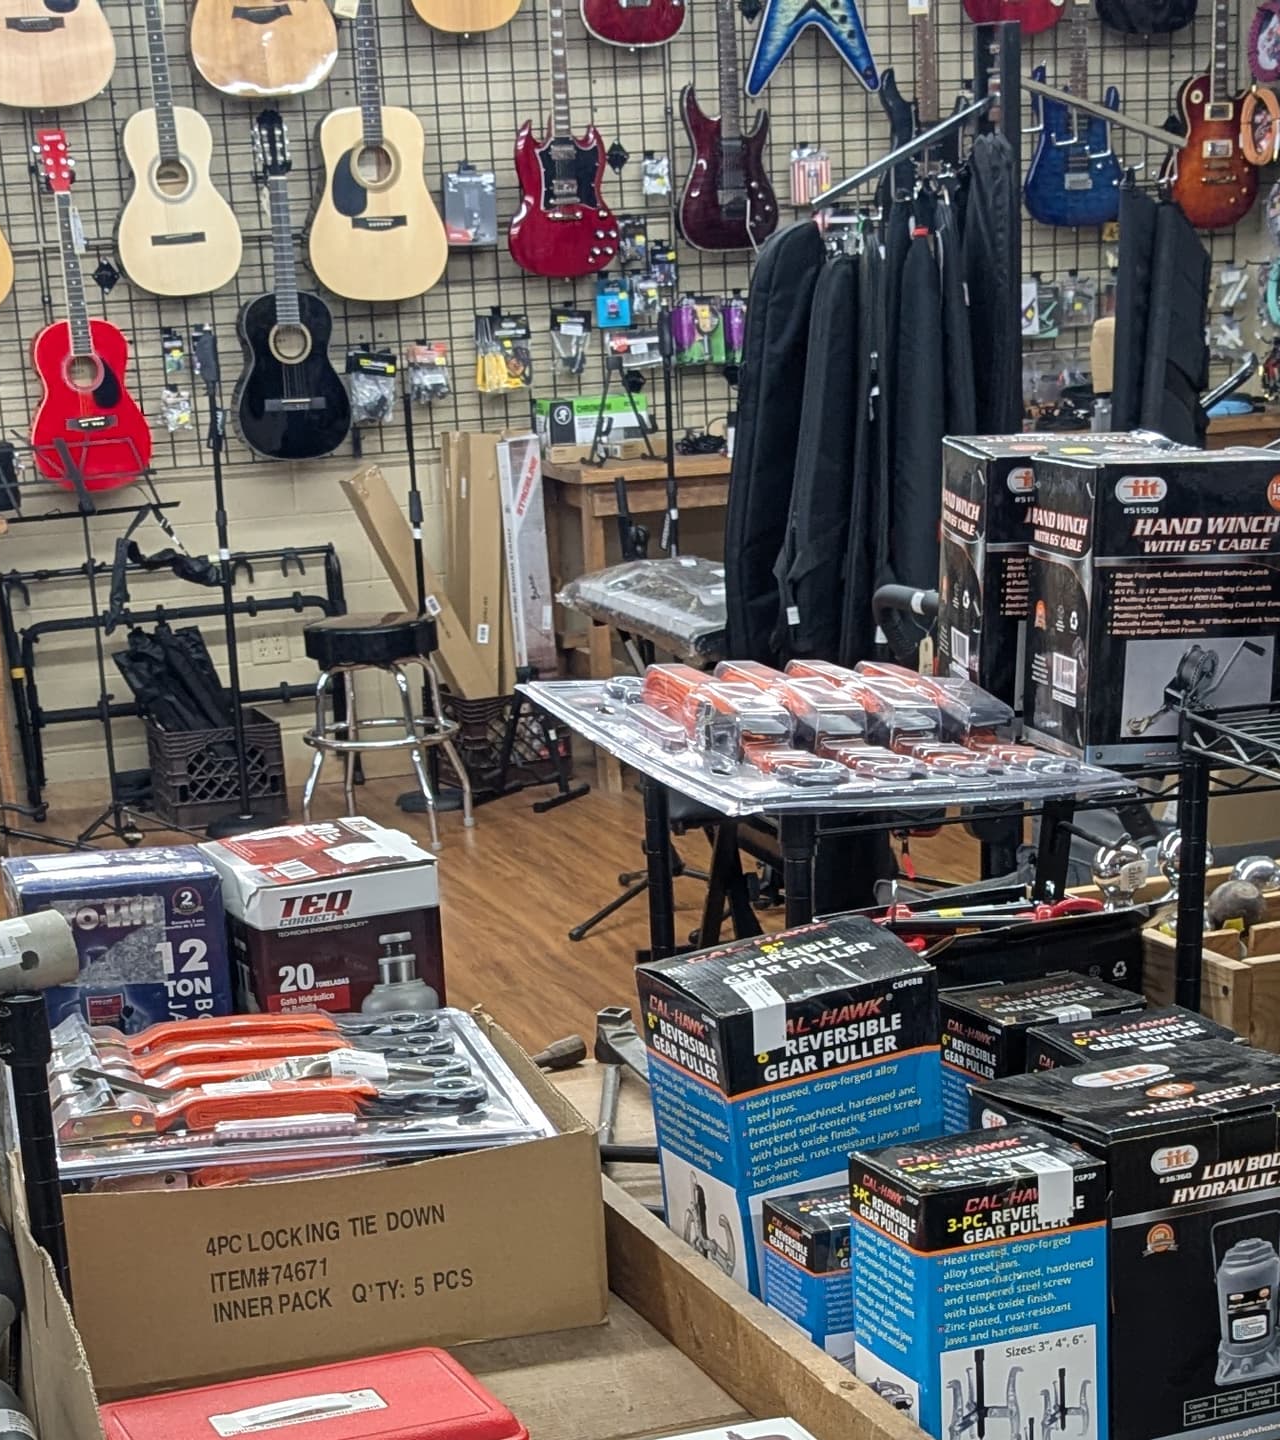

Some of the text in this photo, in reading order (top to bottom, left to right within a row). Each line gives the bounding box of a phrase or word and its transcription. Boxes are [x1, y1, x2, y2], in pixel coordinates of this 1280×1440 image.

[1123, 506, 1159, 514] #51550
[1132, 516, 1203, 536] HAND
[1144, 538, 1271, 553] WITH CABLE
[279, 889, 353, 919] TEQ
[154, 938, 209, 975] 12
[787, 941, 877, 970] PULLER
[164, 976, 212, 998] TON
[278, 962, 315, 993] 20
[786, 995, 884, 1035] AL-HAWK
[659, 1018, 718, 1066] REVERSIBLE
[785, 1013, 902, 1057] REVERSIBLE
[1098, 1020, 1201, 1043] REVERSIBLE
[1133, 1027, 1207, 1048] PULLER
[652, 1033, 720, 1085] GEAR PULLER
[764, 1035, 898, 1082] GEAR PULLER
[944, 1049, 995, 1081] GEAR PULLER
[952, 1037, 998, 1067] REVERSIBLE
[813, 1064, 898, 1091] drop-forged alloy
[848, 1090, 896, 1109] hardened
[1201, 1159, 1245, 1181] LOW
[1171, 1174, 1278, 1205] HYDRAULIC
[859, 1203, 910, 1244] GEAR PULLER
[871, 1196, 917, 1235] REVERSIBLE
[947, 1212, 988, 1233] 3-PC.
[205, 1203, 446, 1257] 4PC LOCKING TIE DOWN
[962, 1225, 1006, 1244] GEAR
[1012, 1235, 1072, 1254] drop-forged
[210, 1256, 327, 1294] ITEM#74671
[943, 1267, 968, 1281] alloy
[1046, 1256, 1094, 1273] hardened
[212, 1267, 474, 1324] INNER PACK Q'TY: 5 PCS
[966, 1276, 1072, 1304] tempered steel screw
[943, 1301, 996, 1320] with black
[1005, 1343, 1036, 1359] Sizes:
